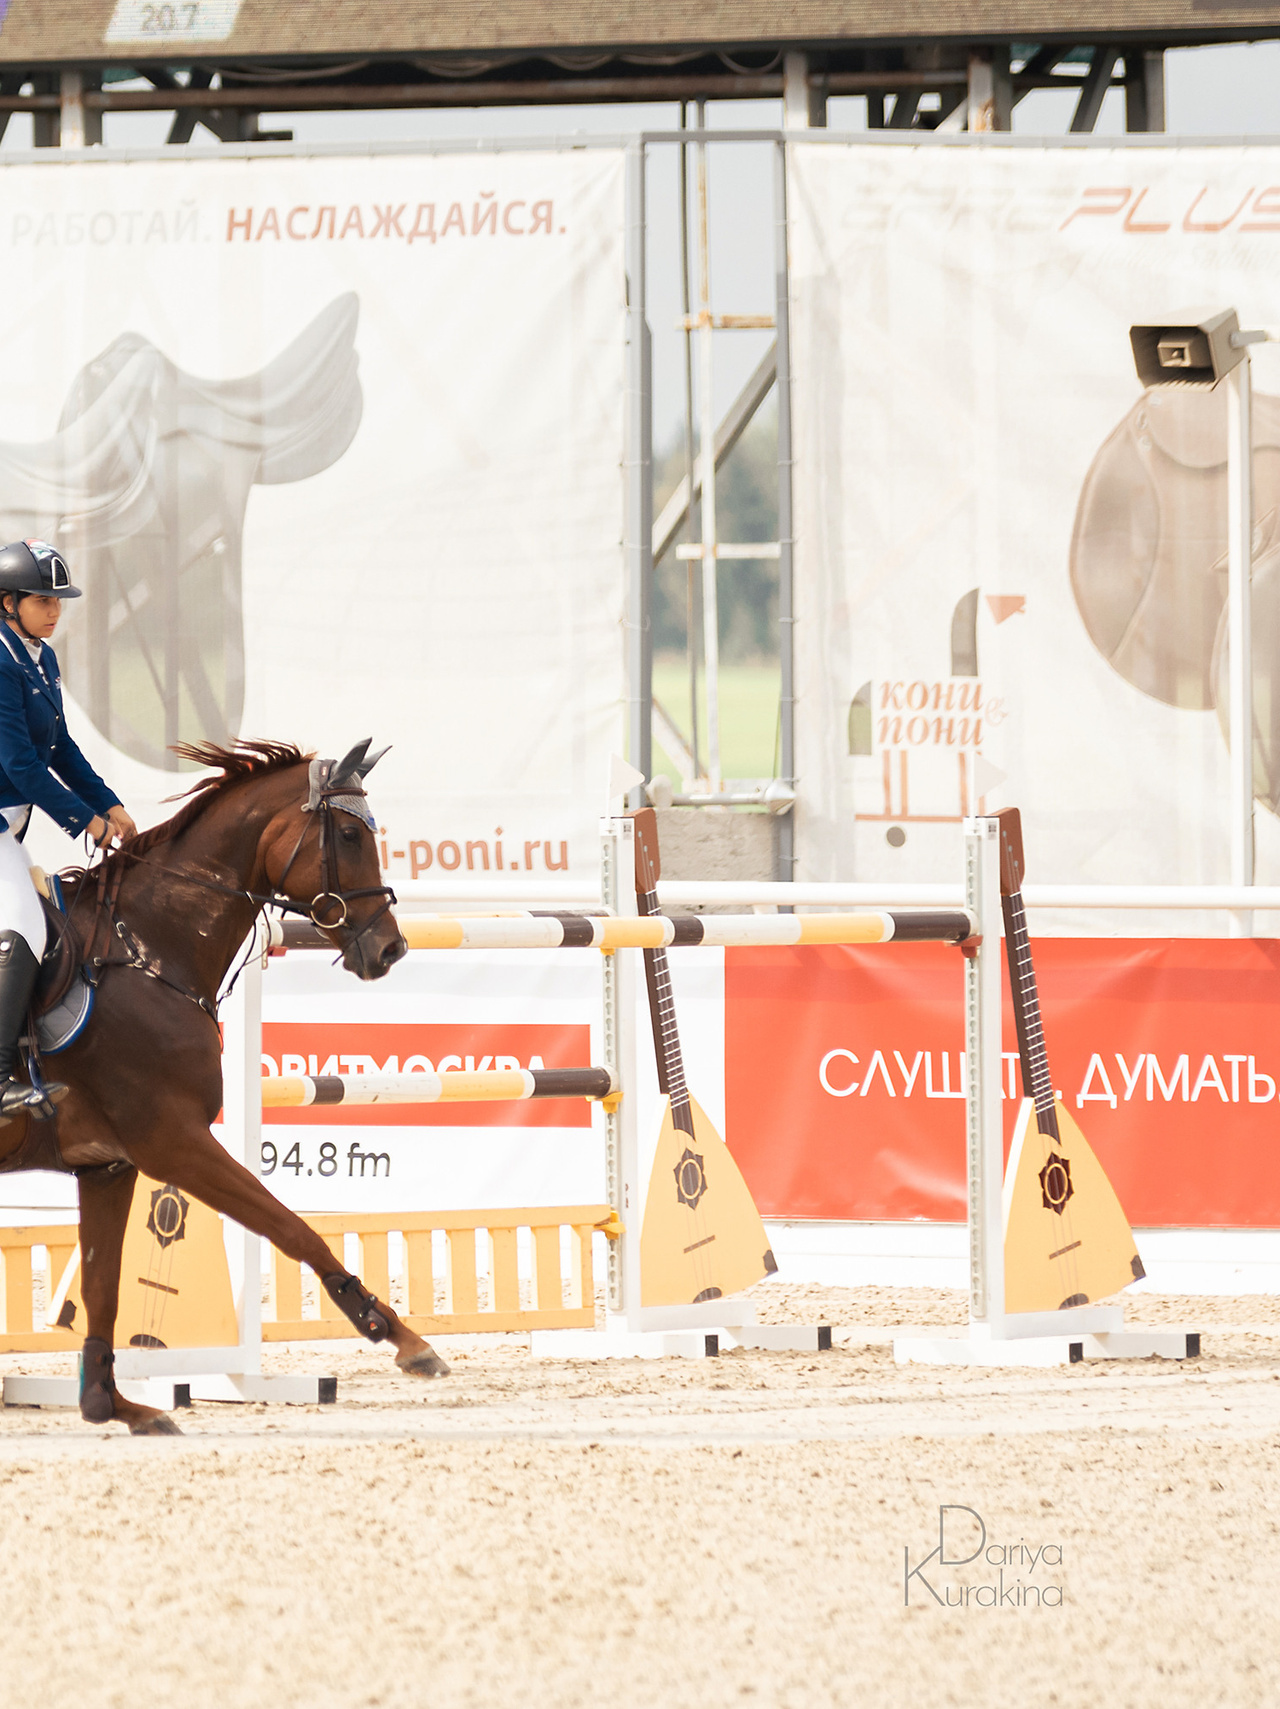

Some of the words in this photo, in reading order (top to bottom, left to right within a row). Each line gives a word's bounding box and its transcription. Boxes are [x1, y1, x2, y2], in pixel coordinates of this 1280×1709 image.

[10, 199, 212, 248] РАБОТАЙ.
[225, 190, 568, 245] НАСЛАЖДАЙСЯ.
[1076, 1052, 1280, 1109] ДУМАТЬ
[261, 1141, 338, 1178] 94.8
[347, 1142, 391, 1178] fm
